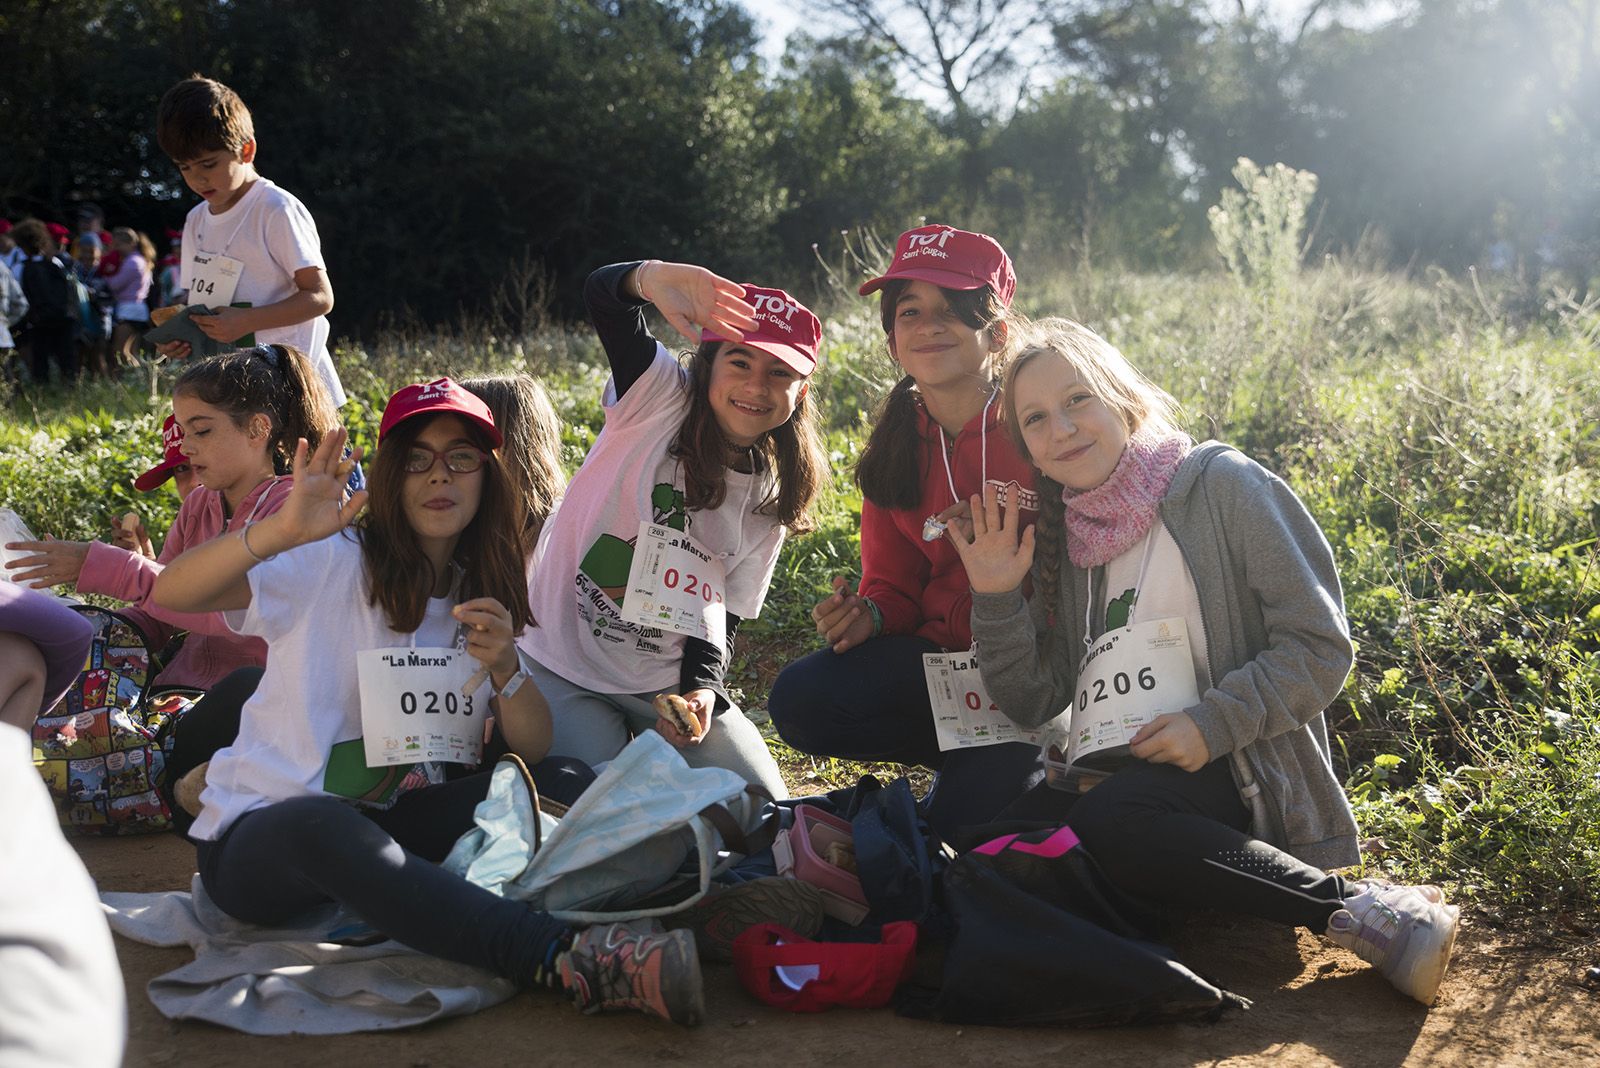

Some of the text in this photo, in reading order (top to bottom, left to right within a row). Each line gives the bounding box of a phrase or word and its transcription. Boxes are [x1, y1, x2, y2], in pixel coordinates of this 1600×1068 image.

[908, 230, 955, 249] TOT
[922, 246, 948, 260] Cugat
[754, 294, 799, 321] TOT
[769, 315, 793, 334] Cugat
[417, 391, 440, 401] Sant
[651, 528, 665, 537] 203
[382, 655, 452, 667] “La Marxa”
[1079, 667, 1156, 712] 0206
[400, 691, 474, 716] 0203
